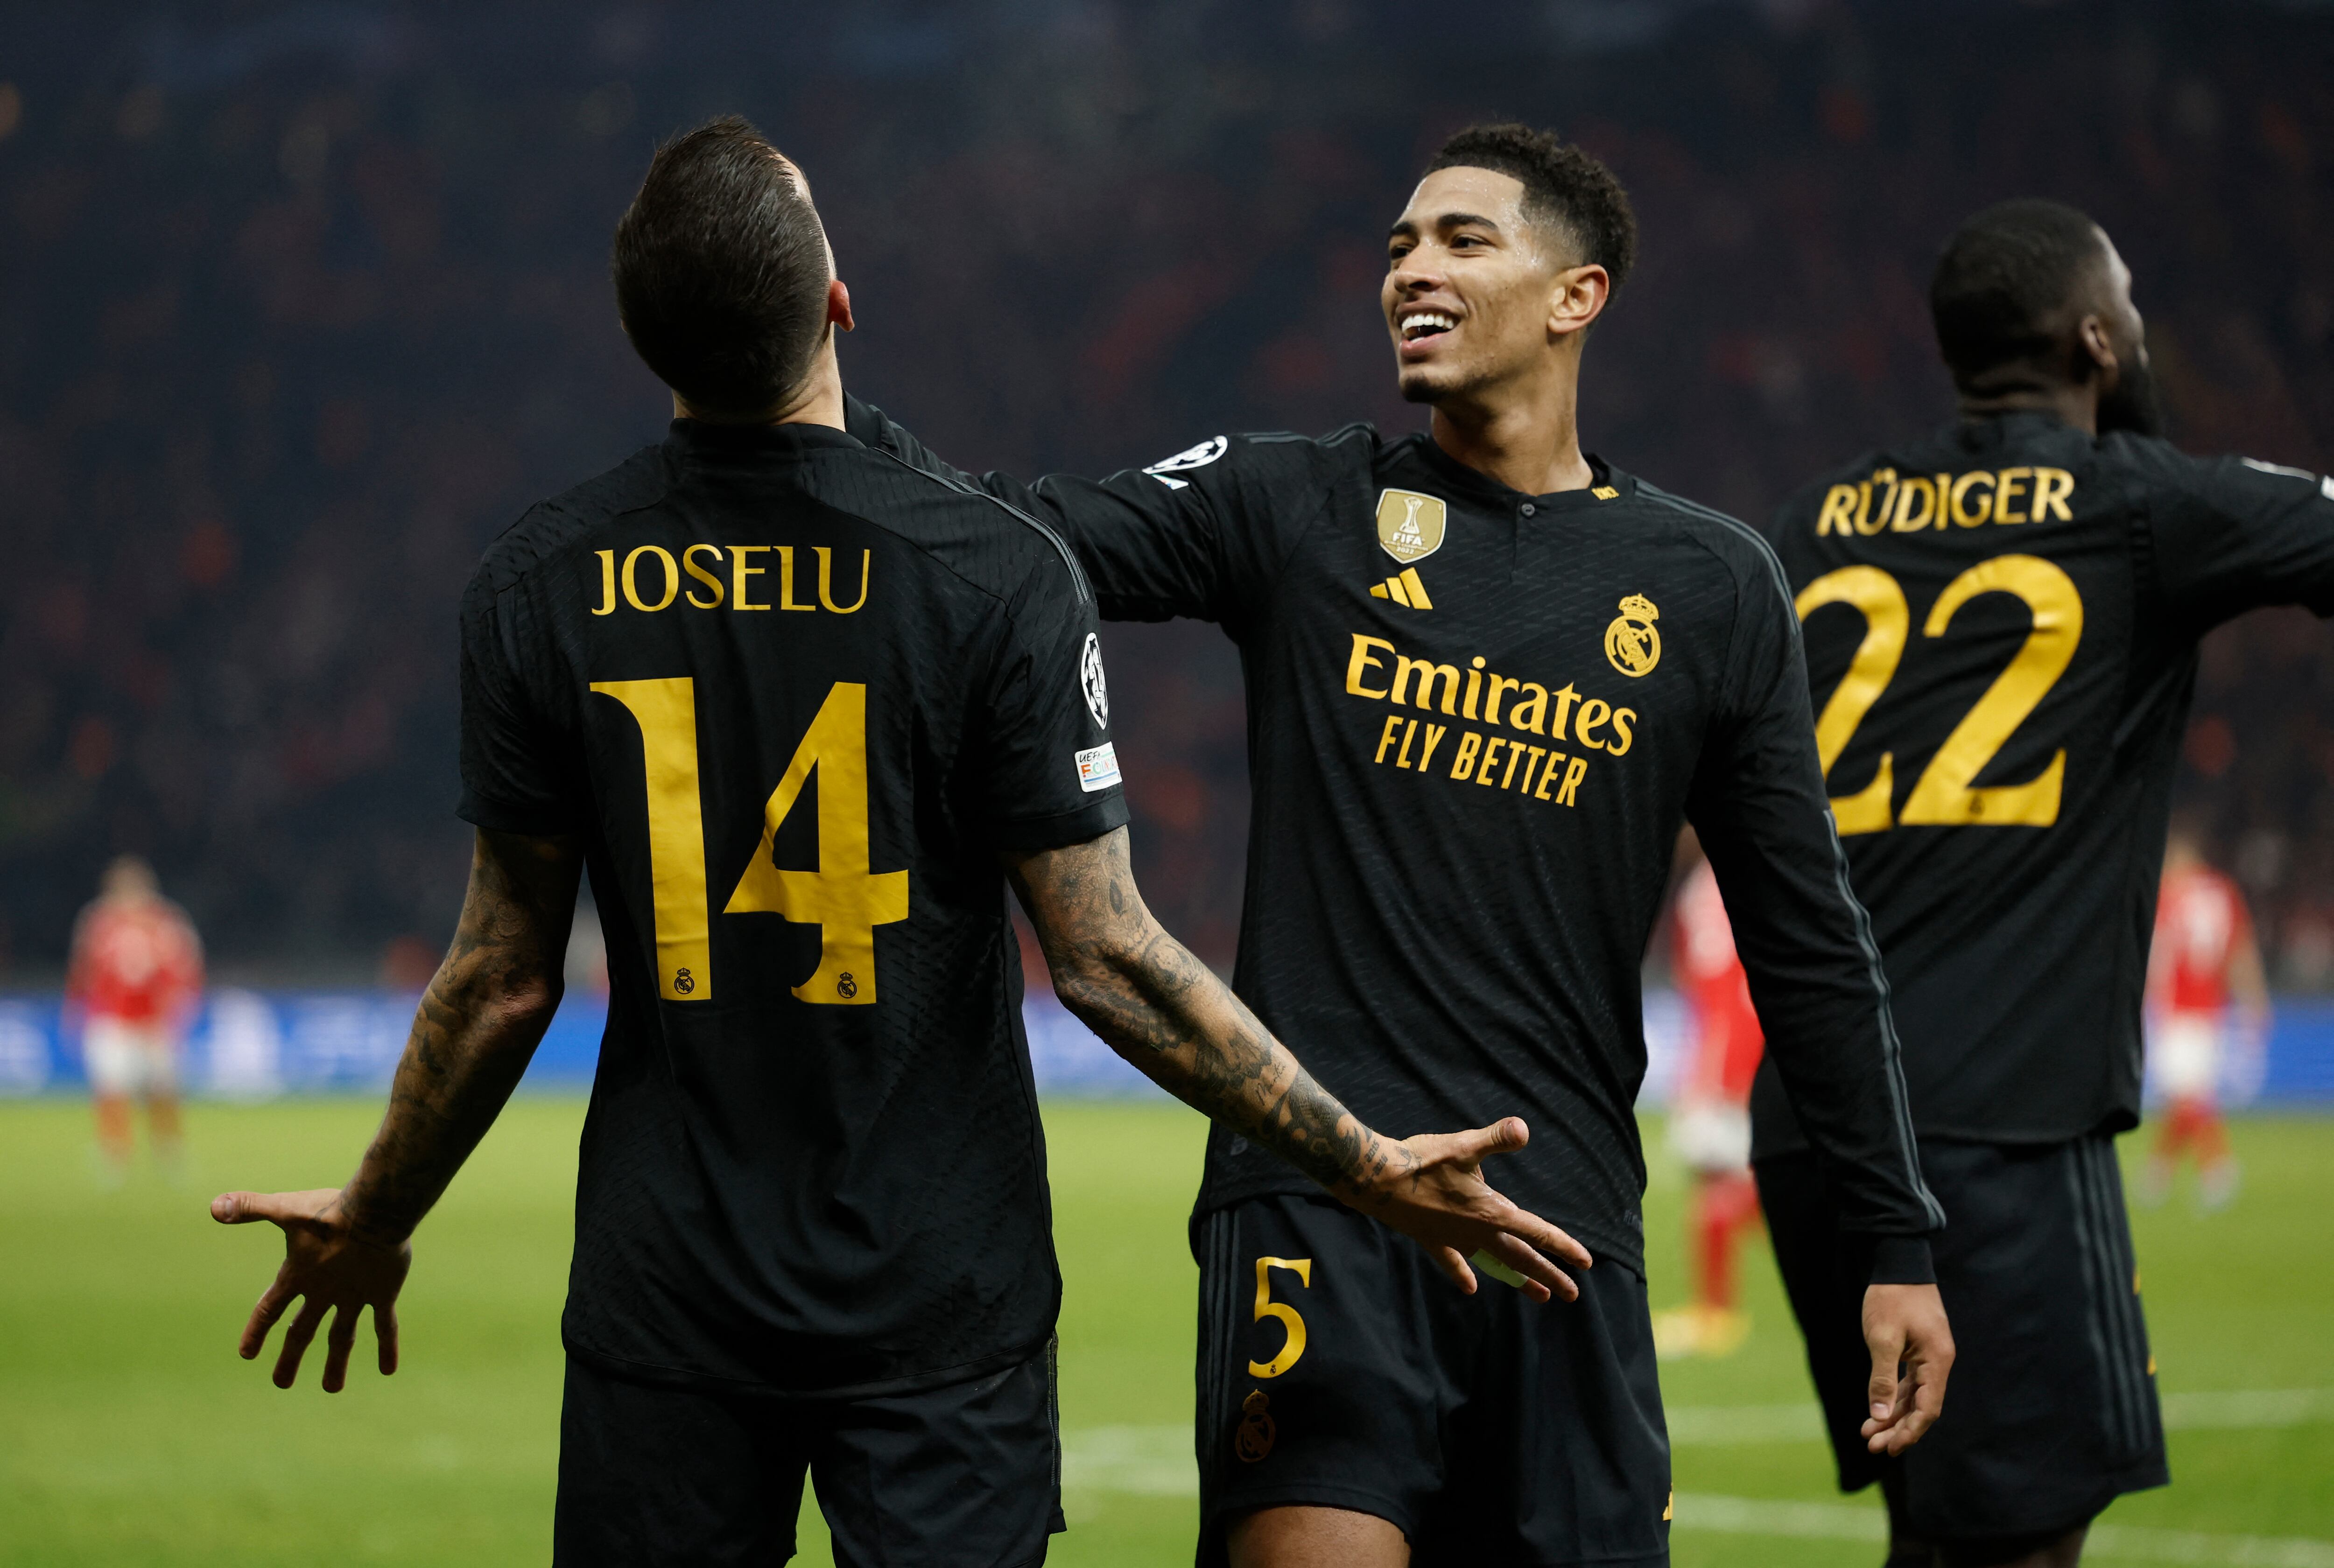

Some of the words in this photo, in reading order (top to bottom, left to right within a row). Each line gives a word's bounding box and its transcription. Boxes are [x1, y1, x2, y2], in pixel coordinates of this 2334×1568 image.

[1392, 532, 1422, 546] FIFA
[1816, 467, 2074, 537] RÜDIGER
[591, 544, 870, 616] JOSELU
[1346, 633, 1637, 756] Emirates
[1795, 553, 2084, 837] 22
[1080, 751, 1101, 763] UEFA
[1374, 714, 1447, 772] FLY
[1449, 731, 1588, 807] BETTER
[589, 677, 909, 1005] 14
[1248, 1256, 1311, 1379] 5
